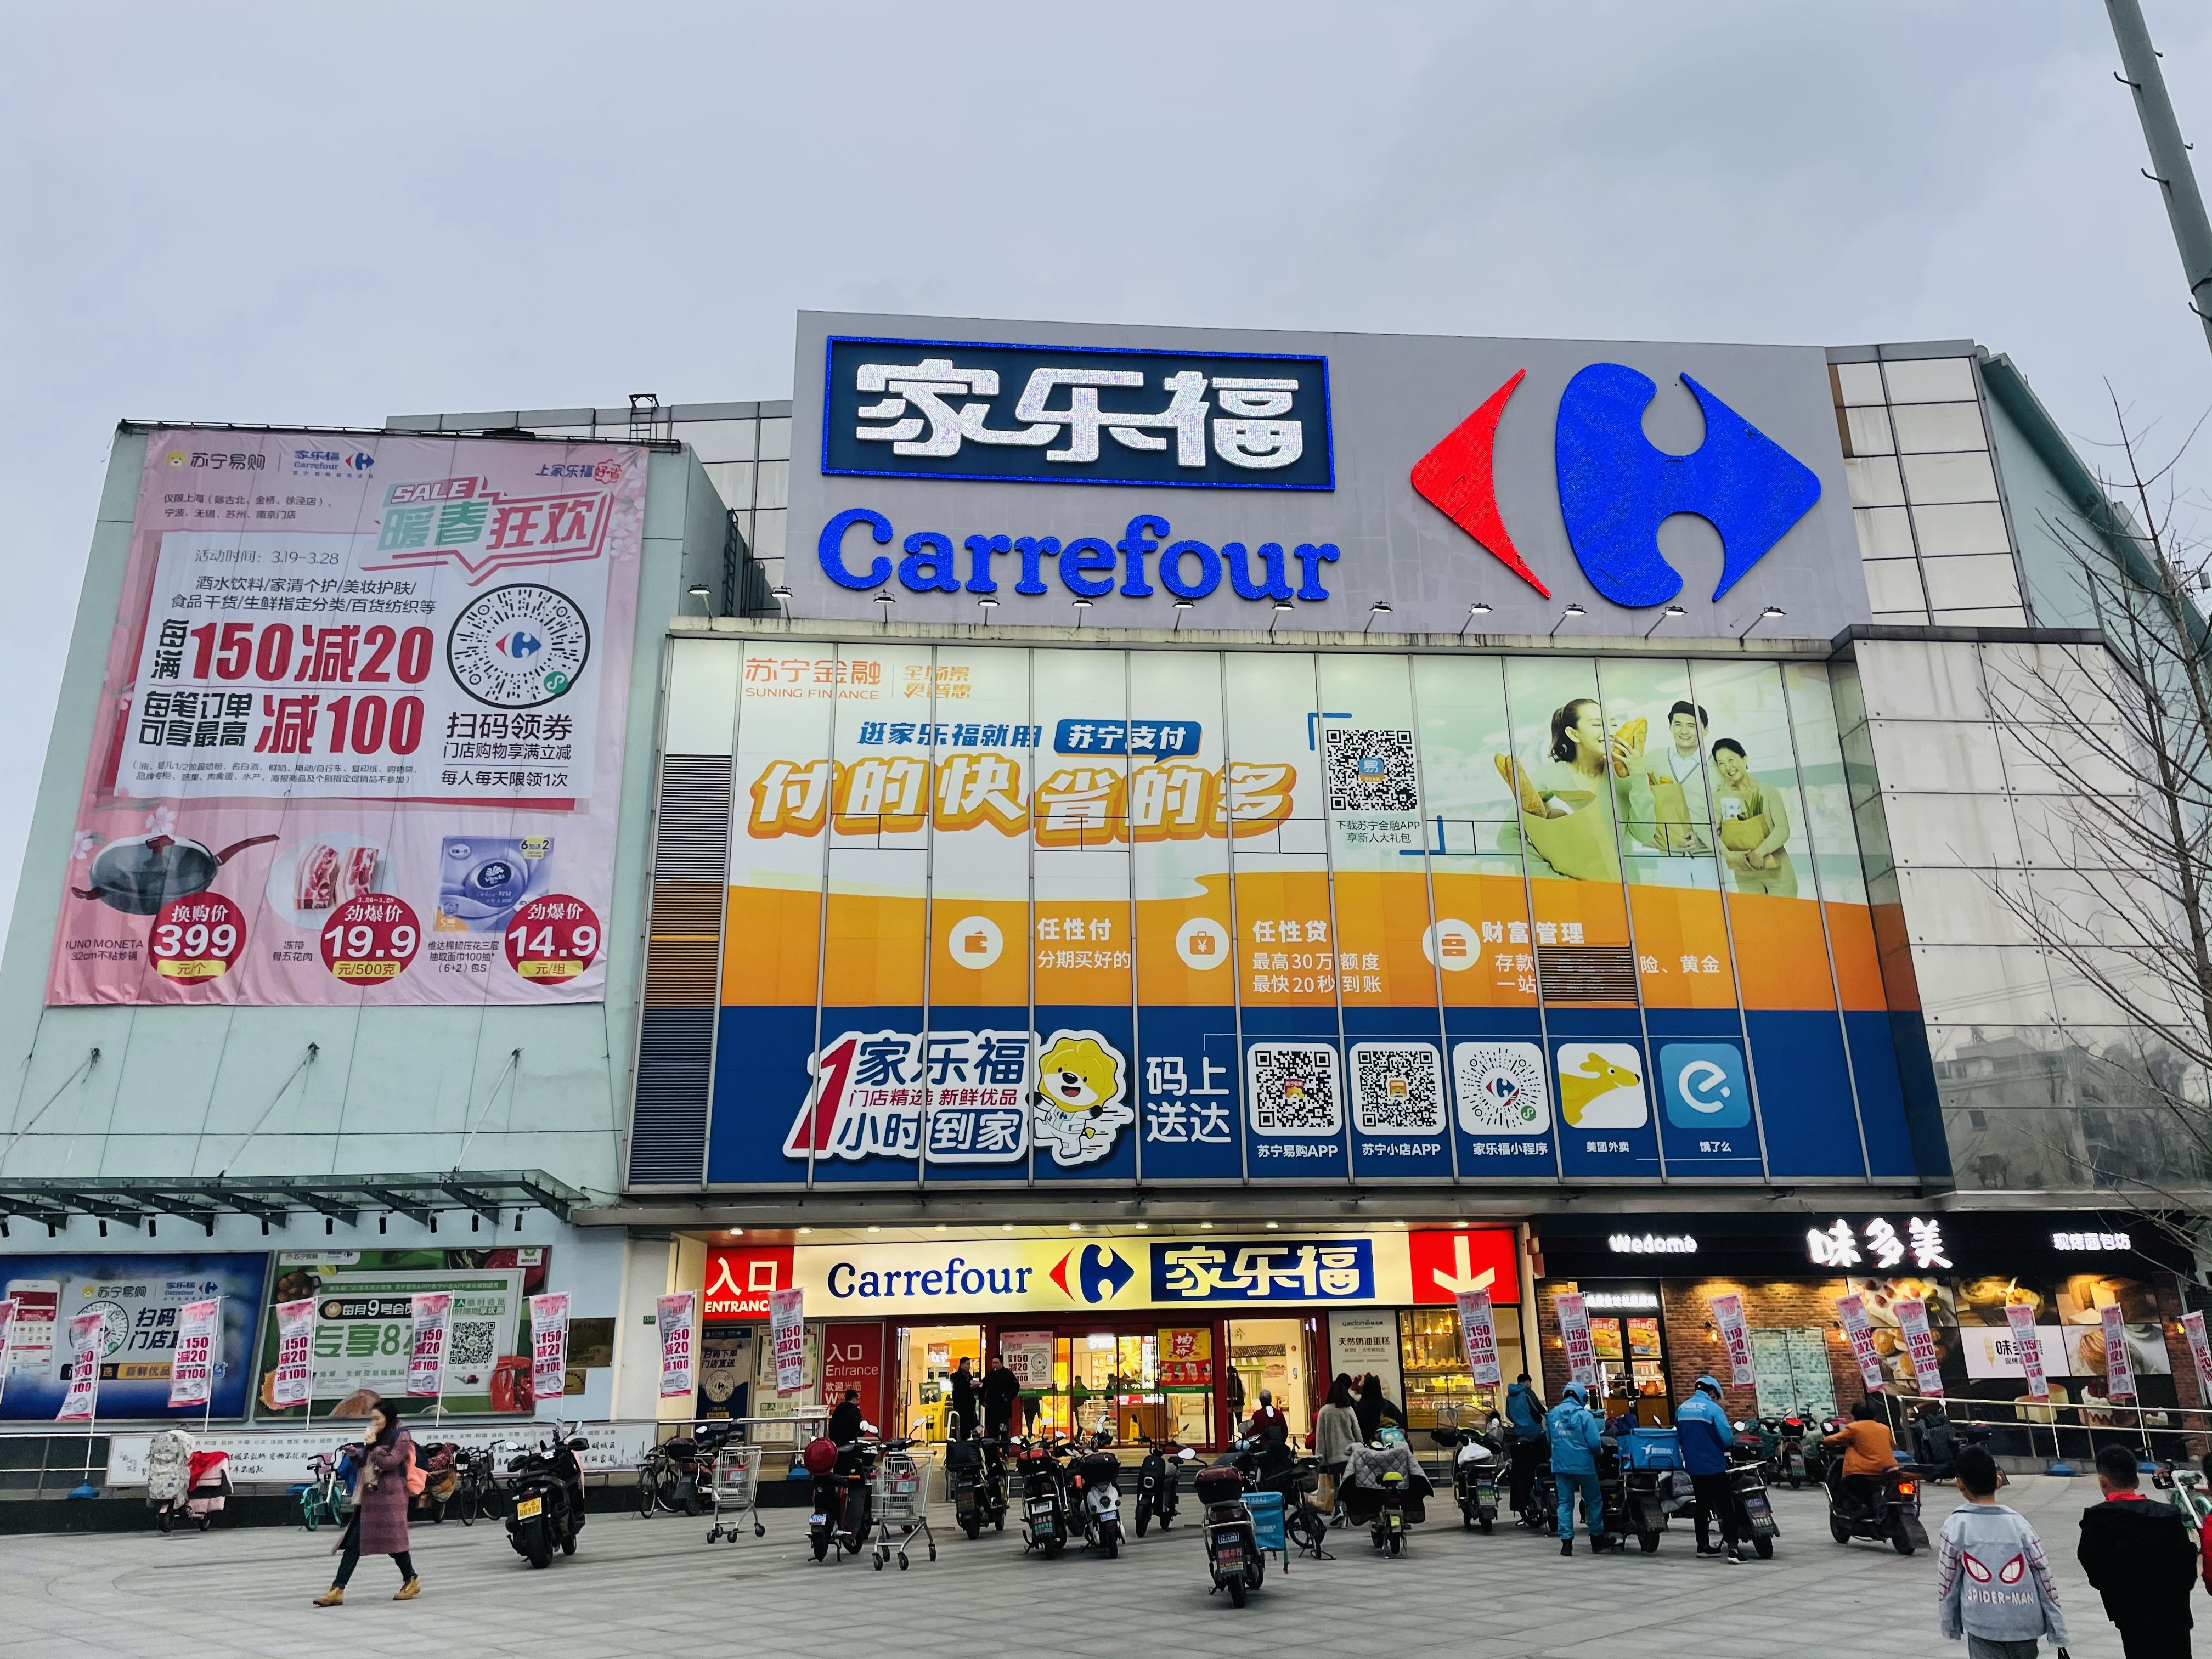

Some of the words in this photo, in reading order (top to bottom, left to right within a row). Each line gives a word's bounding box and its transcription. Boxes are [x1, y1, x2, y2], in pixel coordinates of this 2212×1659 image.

[856, 358, 1304, 470] 家乐福
[190, 453, 266, 470] 苏宁易购
[295, 461, 338, 470] Carrefour
[391, 480, 469, 504] SALE
[377, 500, 594, 550] 暖春狂欢
[818, 507, 1340, 601] Carrefour
[196, 575, 416, 595] 酒水饮料/家清个护/美妆护肤/
[172, 594, 436, 614] 食品干货/生鲜指定分类/百货纺织等
[745, 658, 881, 685] 苏宁金融
[902, 665, 970, 682] 全场景
[746, 687, 803, 698] SUNING
[808, 689, 878, 699] FINANCE
[143, 691, 252, 719] 每笔订单
[138, 719, 248, 747] 可享最高
[253, 694, 424, 755] 减100
[447, 712, 572, 740] 扫码领券
[857, 721, 1042, 747] 逛家乐福就用
[1068, 724, 1186, 751] 苏宁支付
[443, 742, 572, 760] 门店购物享满立减
[441, 770, 568, 787] 每人每天限领1次
[1336, 821, 1420, 831] 下载苏宁金融APP
[1347, 833, 1411, 843] 享新人大礼包
[171, 905, 229, 923] 换购价
[345, 905, 403, 923] 劲爆价
[527, 903, 583, 921] 劲爆价
[1037, 918, 1111, 941] 任性付
[1252, 920, 1327, 943] 任性贷
[1482, 921, 1585, 944] 财富管理
[93, 940, 143, 950] MONETA
[153, 924, 237, 957] 399
[324, 926, 417, 957] 19.9
[508, 926, 598, 957] 14.9
[71, 950, 137, 962] 32cm不粘炒锅
[272, 951, 313, 962] 骨五花肉
[1037, 951, 1131, 969] 分期买好的
[1252, 953, 1380, 971] 最高30万额度
[177, 962, 206, 975] 元/个
[337, 963, 395, 976] 元/500克
[535, 963, 566, 975] 元/组
[1252, 975, 1382, 994] 最快20秒到账
[854, 1037, 1026, 1086] 家乐福
[1146, 1057, 1229, 1096] 码上
[792, 1039, 857, 1150] 1
[849, 1089, 933, 1107] 门店精选
[939, 1088, 1017, 1106] 新鲜优品
[1147, 1101, 1231, 1143] 送达
[1257, 1144, 1338, 1158] 苏宁易购APP
[1362, 1143, 1441, 1156] 苏宁小店APP
[1473, 1143, 1548, 1155] 家乐福小程序
[1587, 1142, 1630, 1153] 美团外卖
[1699, 1141, 1732, 1152] 饿了么
[1807, 1217, 1953, 1269] 味多美
[706, 1257, 778, 1297] 入口
[827, 1257, 1032, 1299] Carrefour
[1165, 1246, 1360, 1296] 家乐福
[97, 1286, 147, 1298] 苏宁易购
[704, 1300, 770, 1312] ENTRANC
[136, 1307, 182, 1327] 扫码
[422, 1329, 442, 1341] 150
[541, 1330, 561, 1344] 150
[781, 1325, 800, 1338] 150
[1470, 1324, 1490, 1336] 150
[1570, 1328, 1587, 1340] 150
[1912, 1333, 1931, 1345] 150
[186, 1336, 209, 1349] 150
[285, 1336, 308, 1350] 150
[1339, 1336, 1390, 1346] 天然奶油蛋糕
[826, 1343, 862, 1362] 入口
[826, 1365, 878, 1376] Entrance
[825, 1381, 862, 1392] 欢迎光临
[1967, 1589, 2034, 1606] SPIDER-MAN
